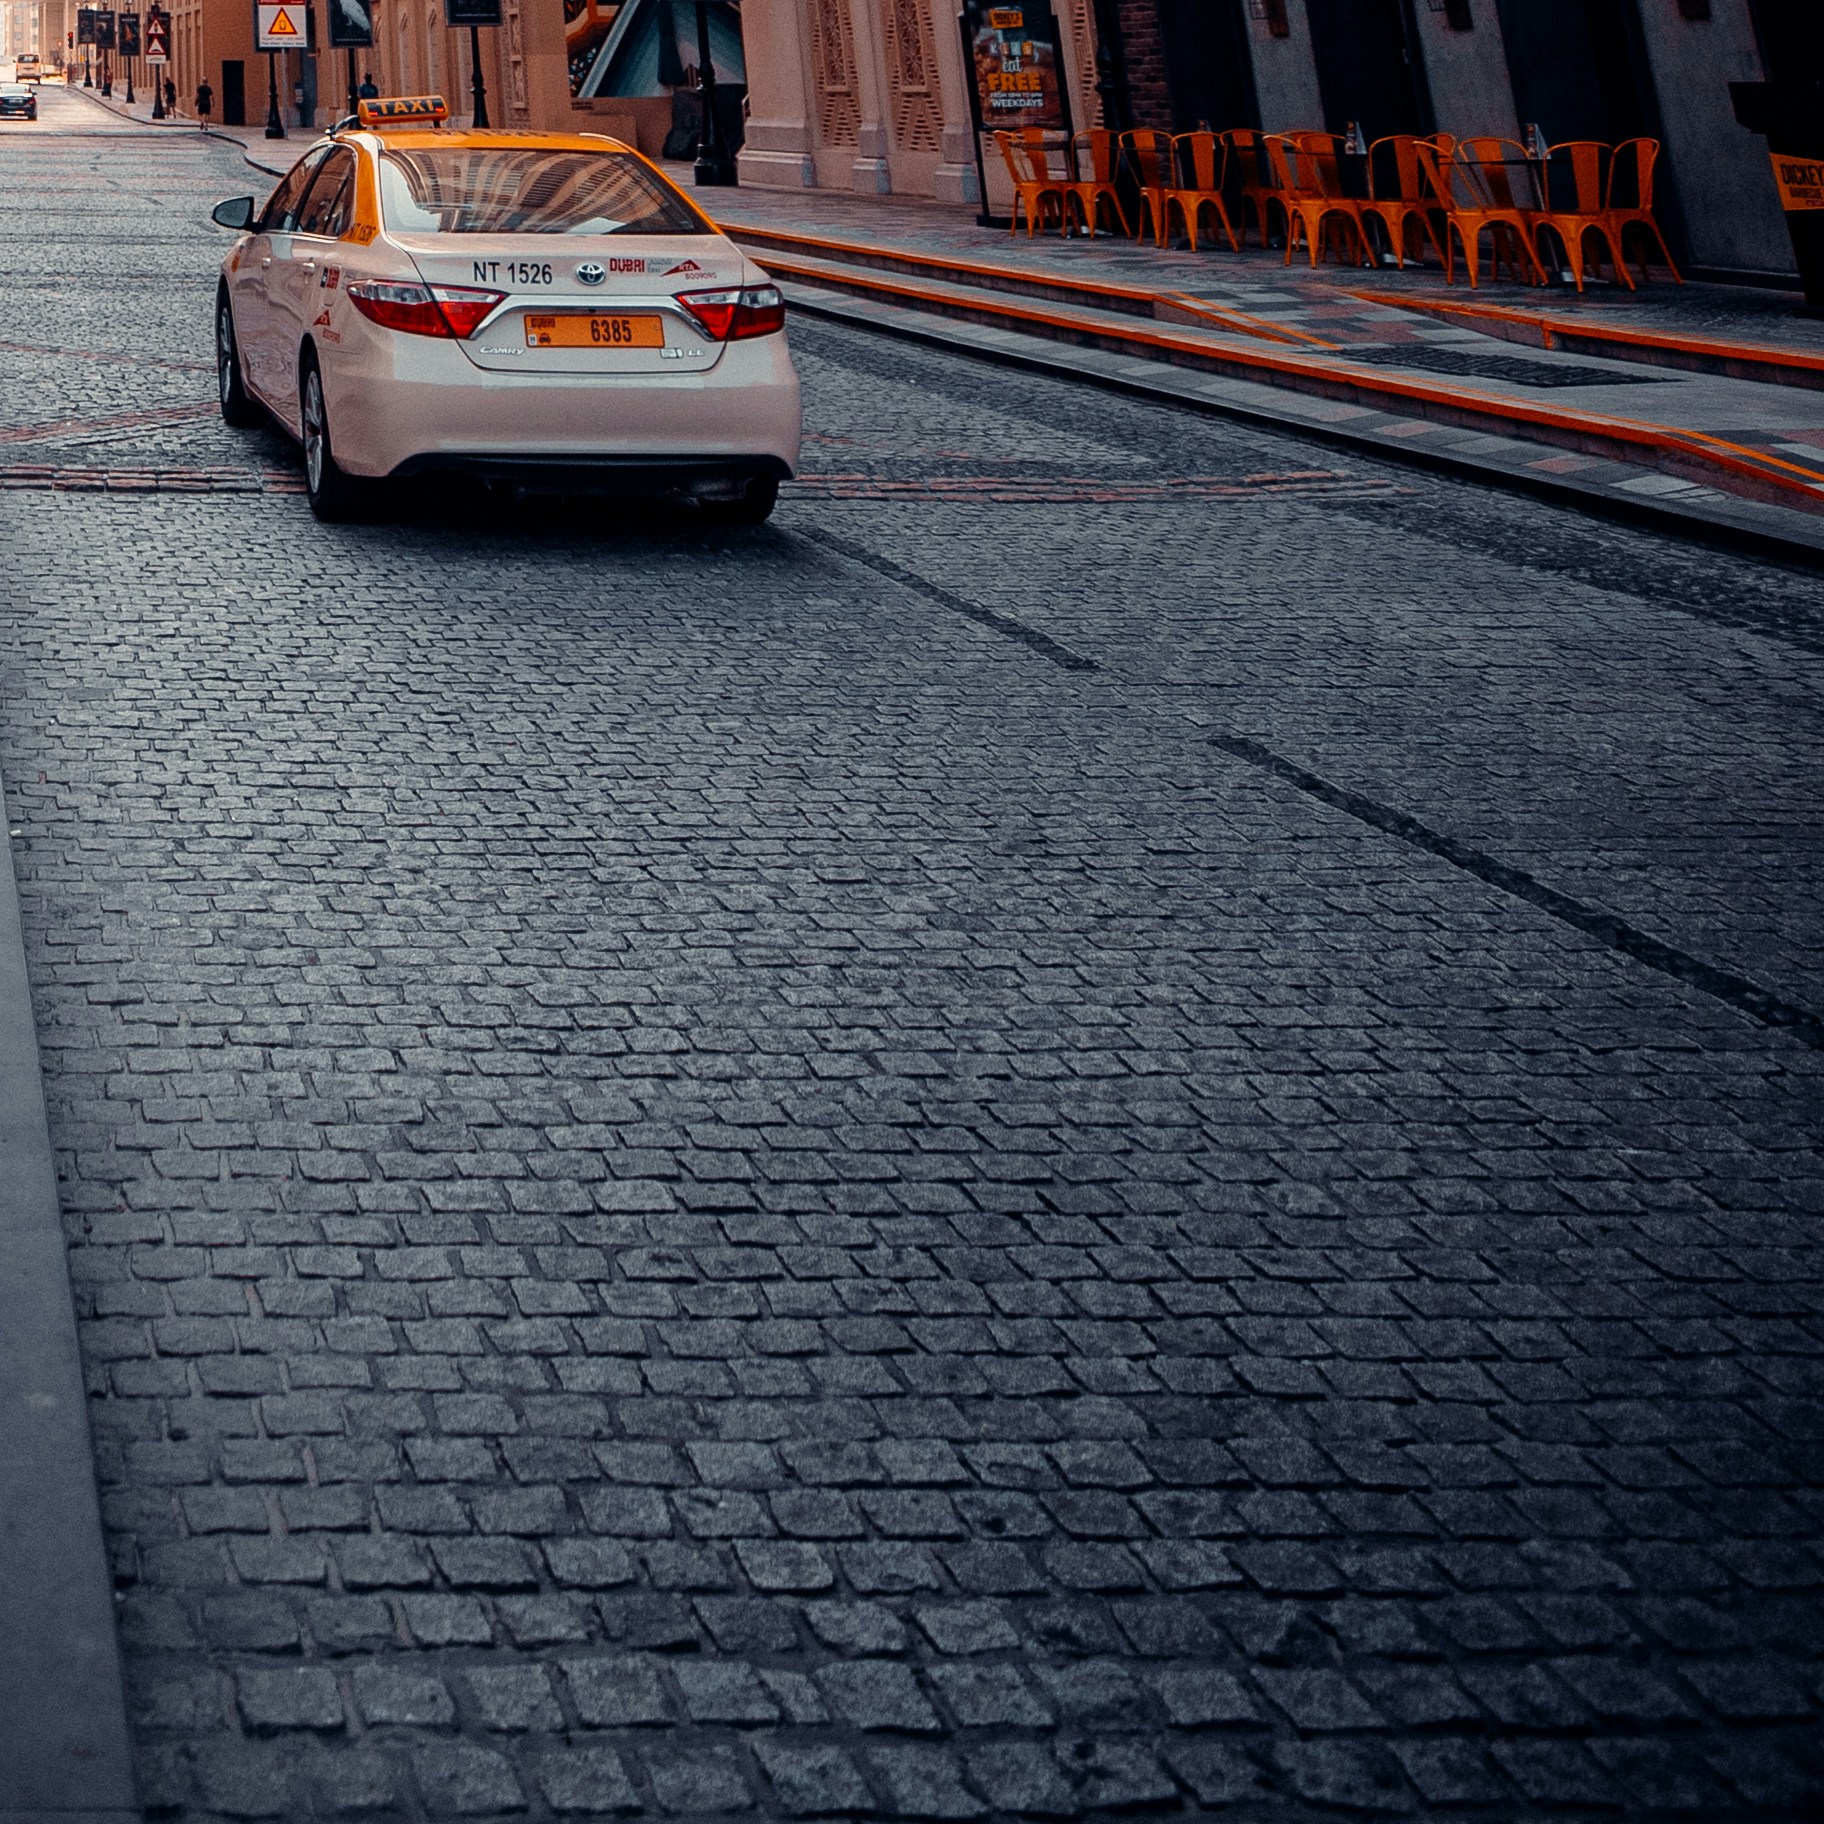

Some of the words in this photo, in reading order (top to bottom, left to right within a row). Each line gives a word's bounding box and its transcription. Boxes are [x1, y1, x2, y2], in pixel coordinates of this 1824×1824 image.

[987, 72, 1042, 91] FREE
[378, 99, 435, 115] TAXI
[991, 98, 1044, 108] WEEKDAYS
[473, 261, 501, 283] NT
[507, 262, 553, 285] 1526
[590, 319, 633, 343] 6385
